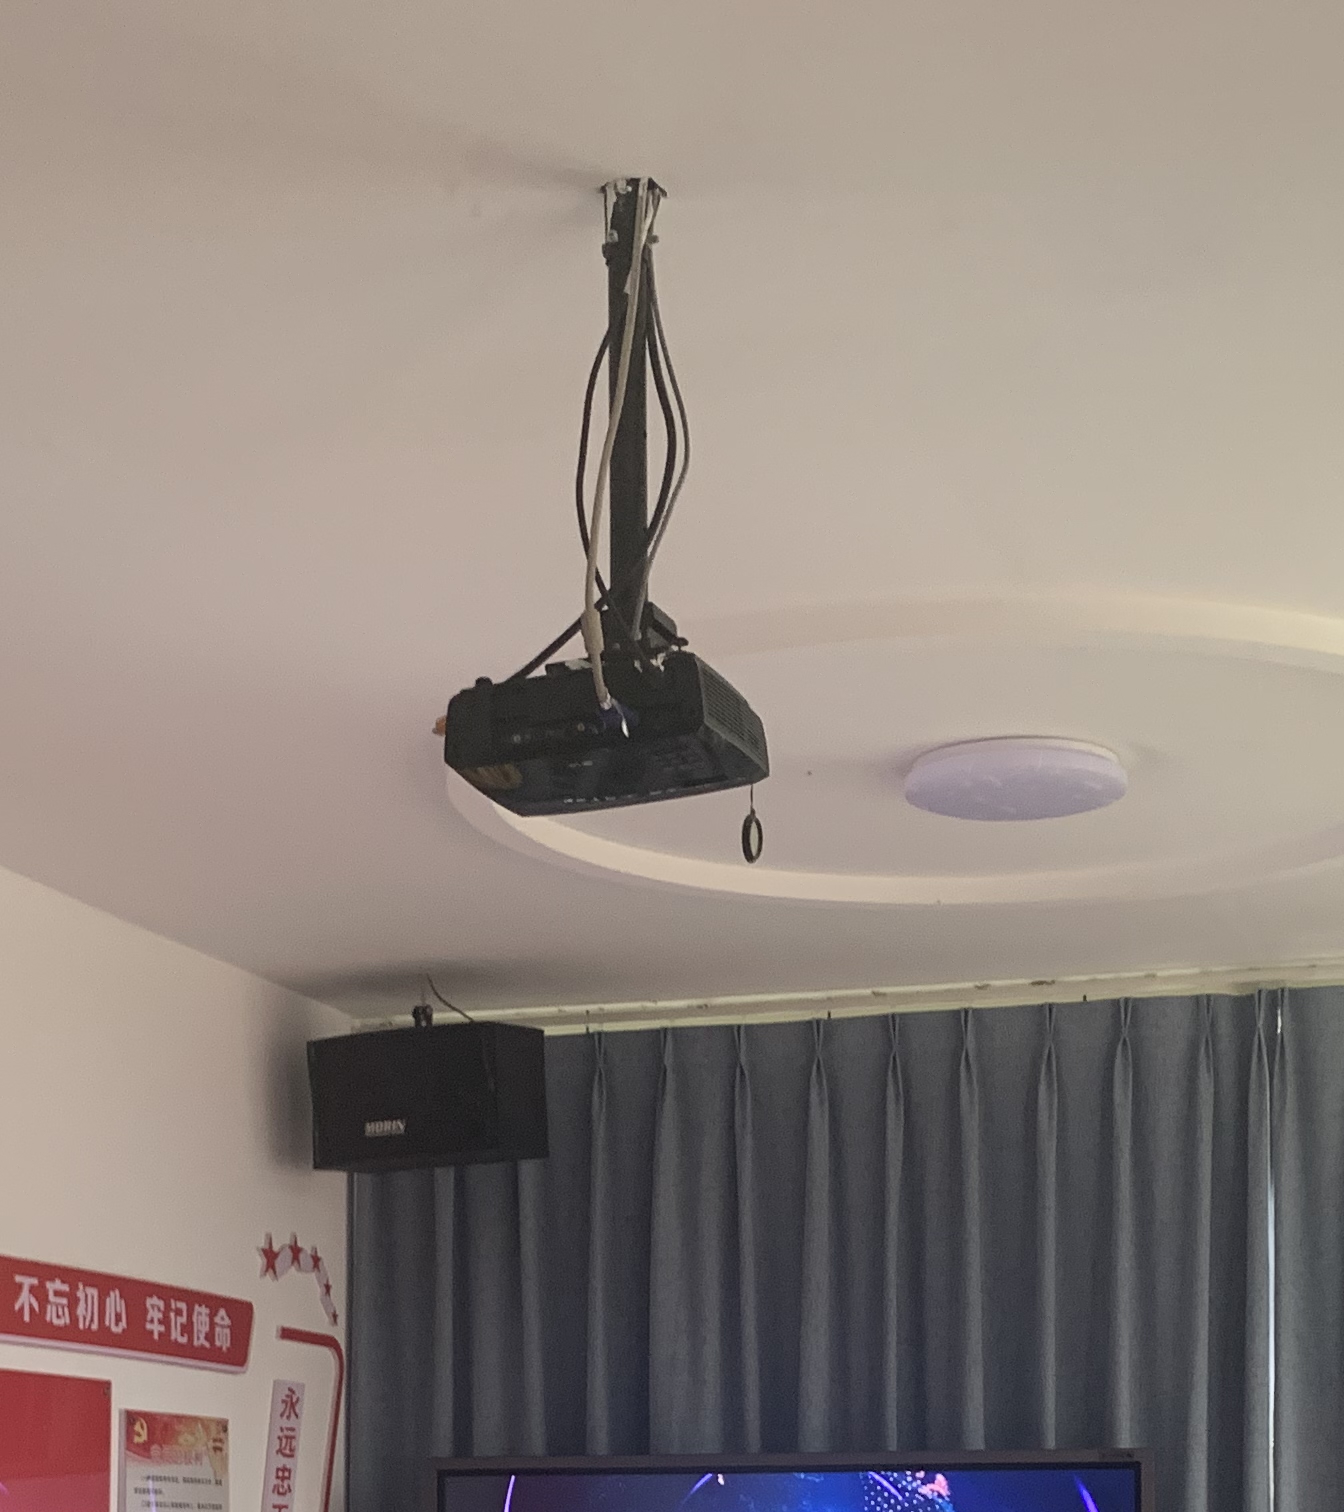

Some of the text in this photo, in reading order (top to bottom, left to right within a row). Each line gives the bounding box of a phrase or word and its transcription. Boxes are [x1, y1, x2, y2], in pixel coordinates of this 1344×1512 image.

[14, 1274, 232, 1352] 不忘初心 牢记使命
